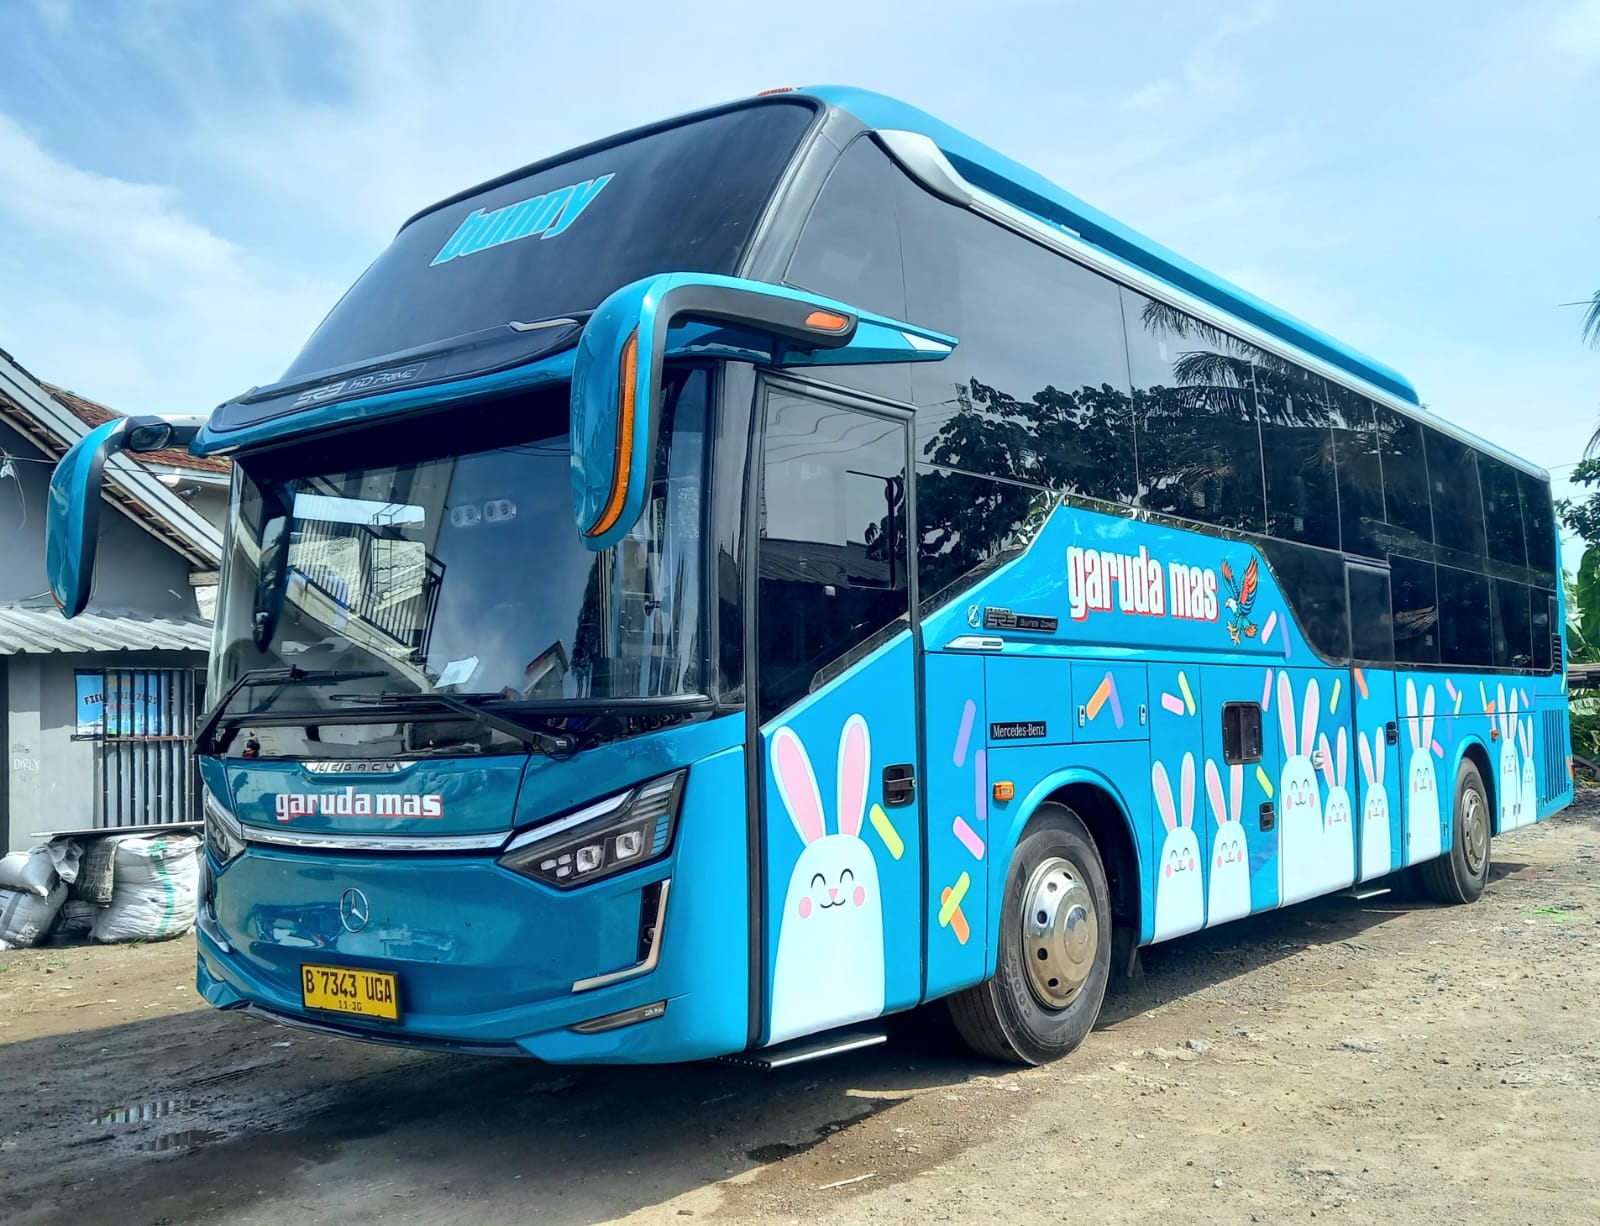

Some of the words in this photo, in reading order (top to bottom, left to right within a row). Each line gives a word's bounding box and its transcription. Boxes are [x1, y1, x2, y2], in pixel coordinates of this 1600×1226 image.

[1066, 544, 1166, 622] garuda
[1168, 561, 1219, 622] mas
[992, 723, 1045, 738] Mercedes-Benz
[317, 762, 396, 773] LEGACY
[275, 785, 373, 824] garuda
[374, 793, 444, 819] mas
[304, 969, 316, 994] B
[320, 970, 358, 999] 7343
[364, 975, 394, 1004] UGA
